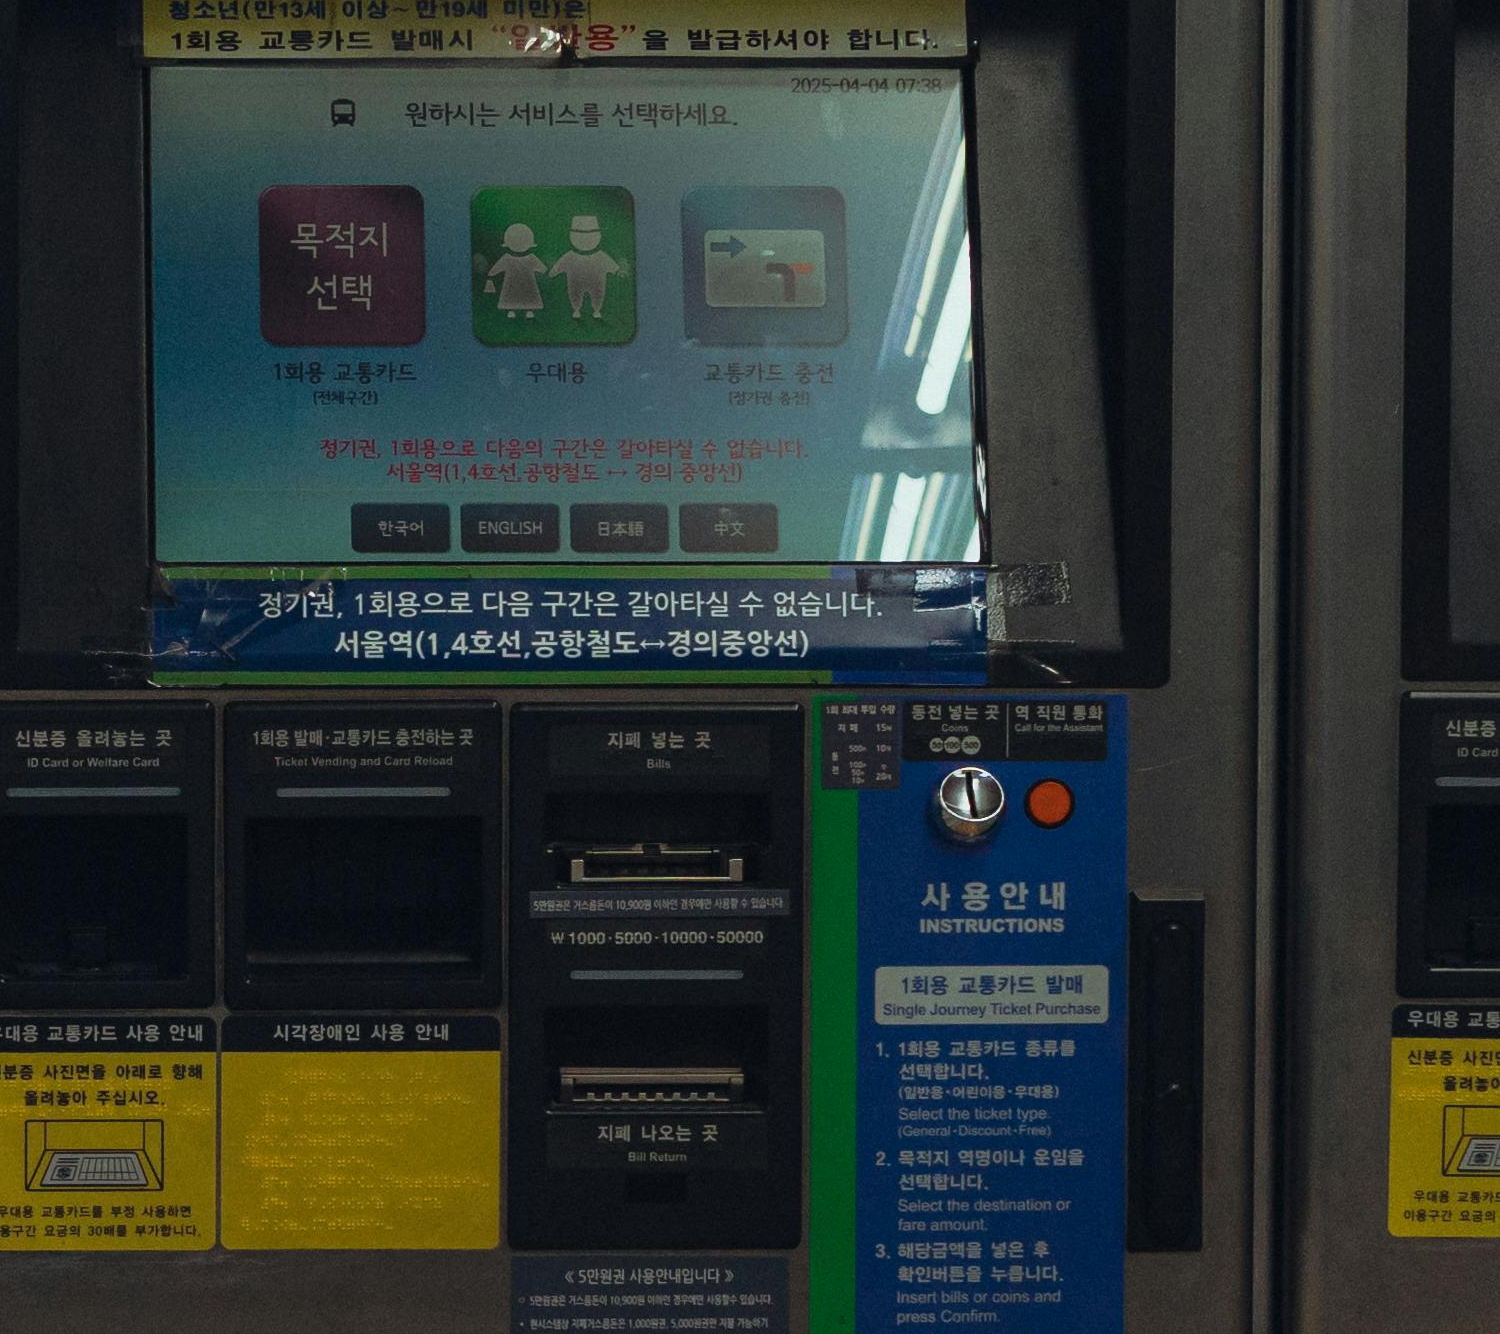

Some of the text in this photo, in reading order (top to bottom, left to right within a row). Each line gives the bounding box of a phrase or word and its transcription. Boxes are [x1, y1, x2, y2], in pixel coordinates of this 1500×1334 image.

[791, 78, 943, 93] 2025-04-04 07:38
[404, 101, 742, 131] 원하시는 서비스를 선택하세요.
[290, 221, 388, 259] 목적지
[306, 273, 373, 312] 선택
[377, 519, 424, 538] 한국어
[478, 520, 543, 535] ENGLISH
[597, 520, 645, 537] 日本語
[257, 588, 883, 622] 정기권, 1회용으로 다음 구간은 갈아타실 수 없습니다.
[15, 729, 173, 749] 신분증 올려놓는 곳
[26, 756, 160, 769] ID Card or Welfare Card
[920, 917, 1065, 933] INSTRUCTIONS
[882, 1001, 1102, 1020] Single Journey Ticket Purchase
[273, 1023, 449, 1042] 시각장애인 사용 안내
[597, 1124, 719, 1143] 지폐 나오는 곳
[627, 1151, 688, 1163] Bill Return
